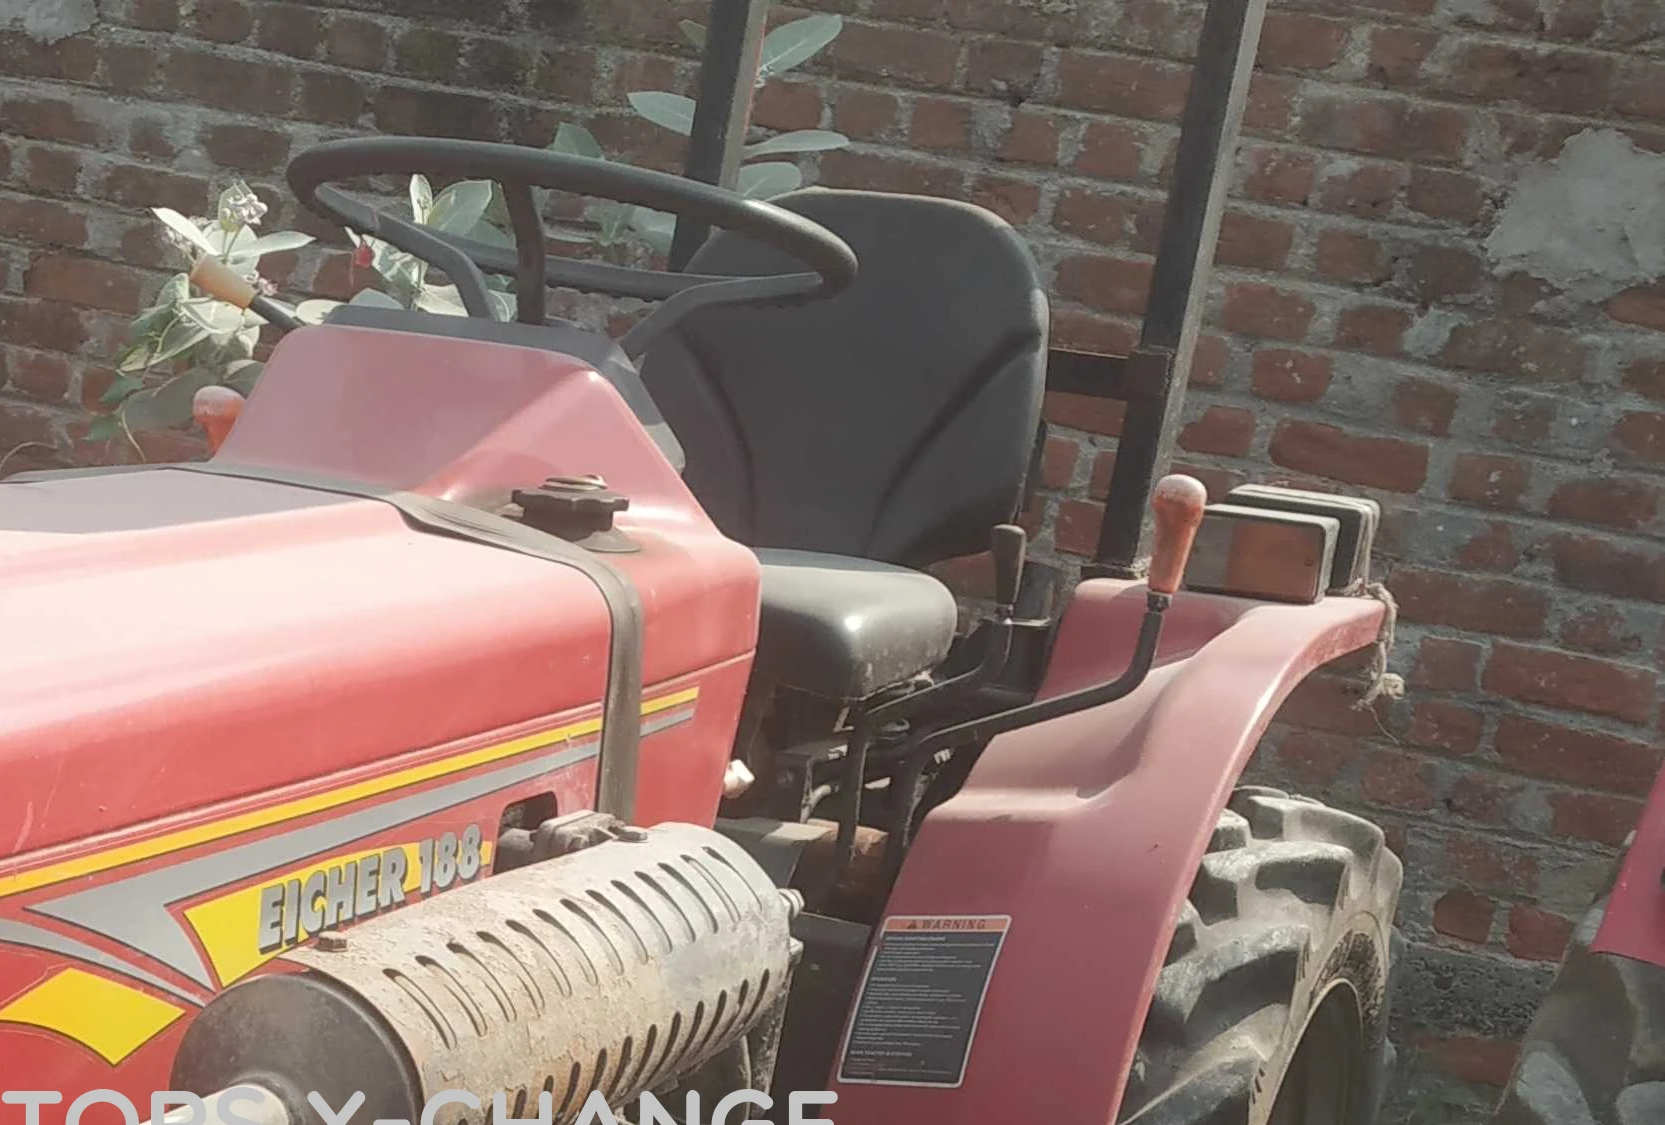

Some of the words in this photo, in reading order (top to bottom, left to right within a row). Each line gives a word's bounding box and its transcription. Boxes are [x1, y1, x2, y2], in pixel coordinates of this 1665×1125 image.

[259, 847, 408, 954] EICHER
[419, 824, 483, 896] 188
[921, 918, 987, 931] WARNING
